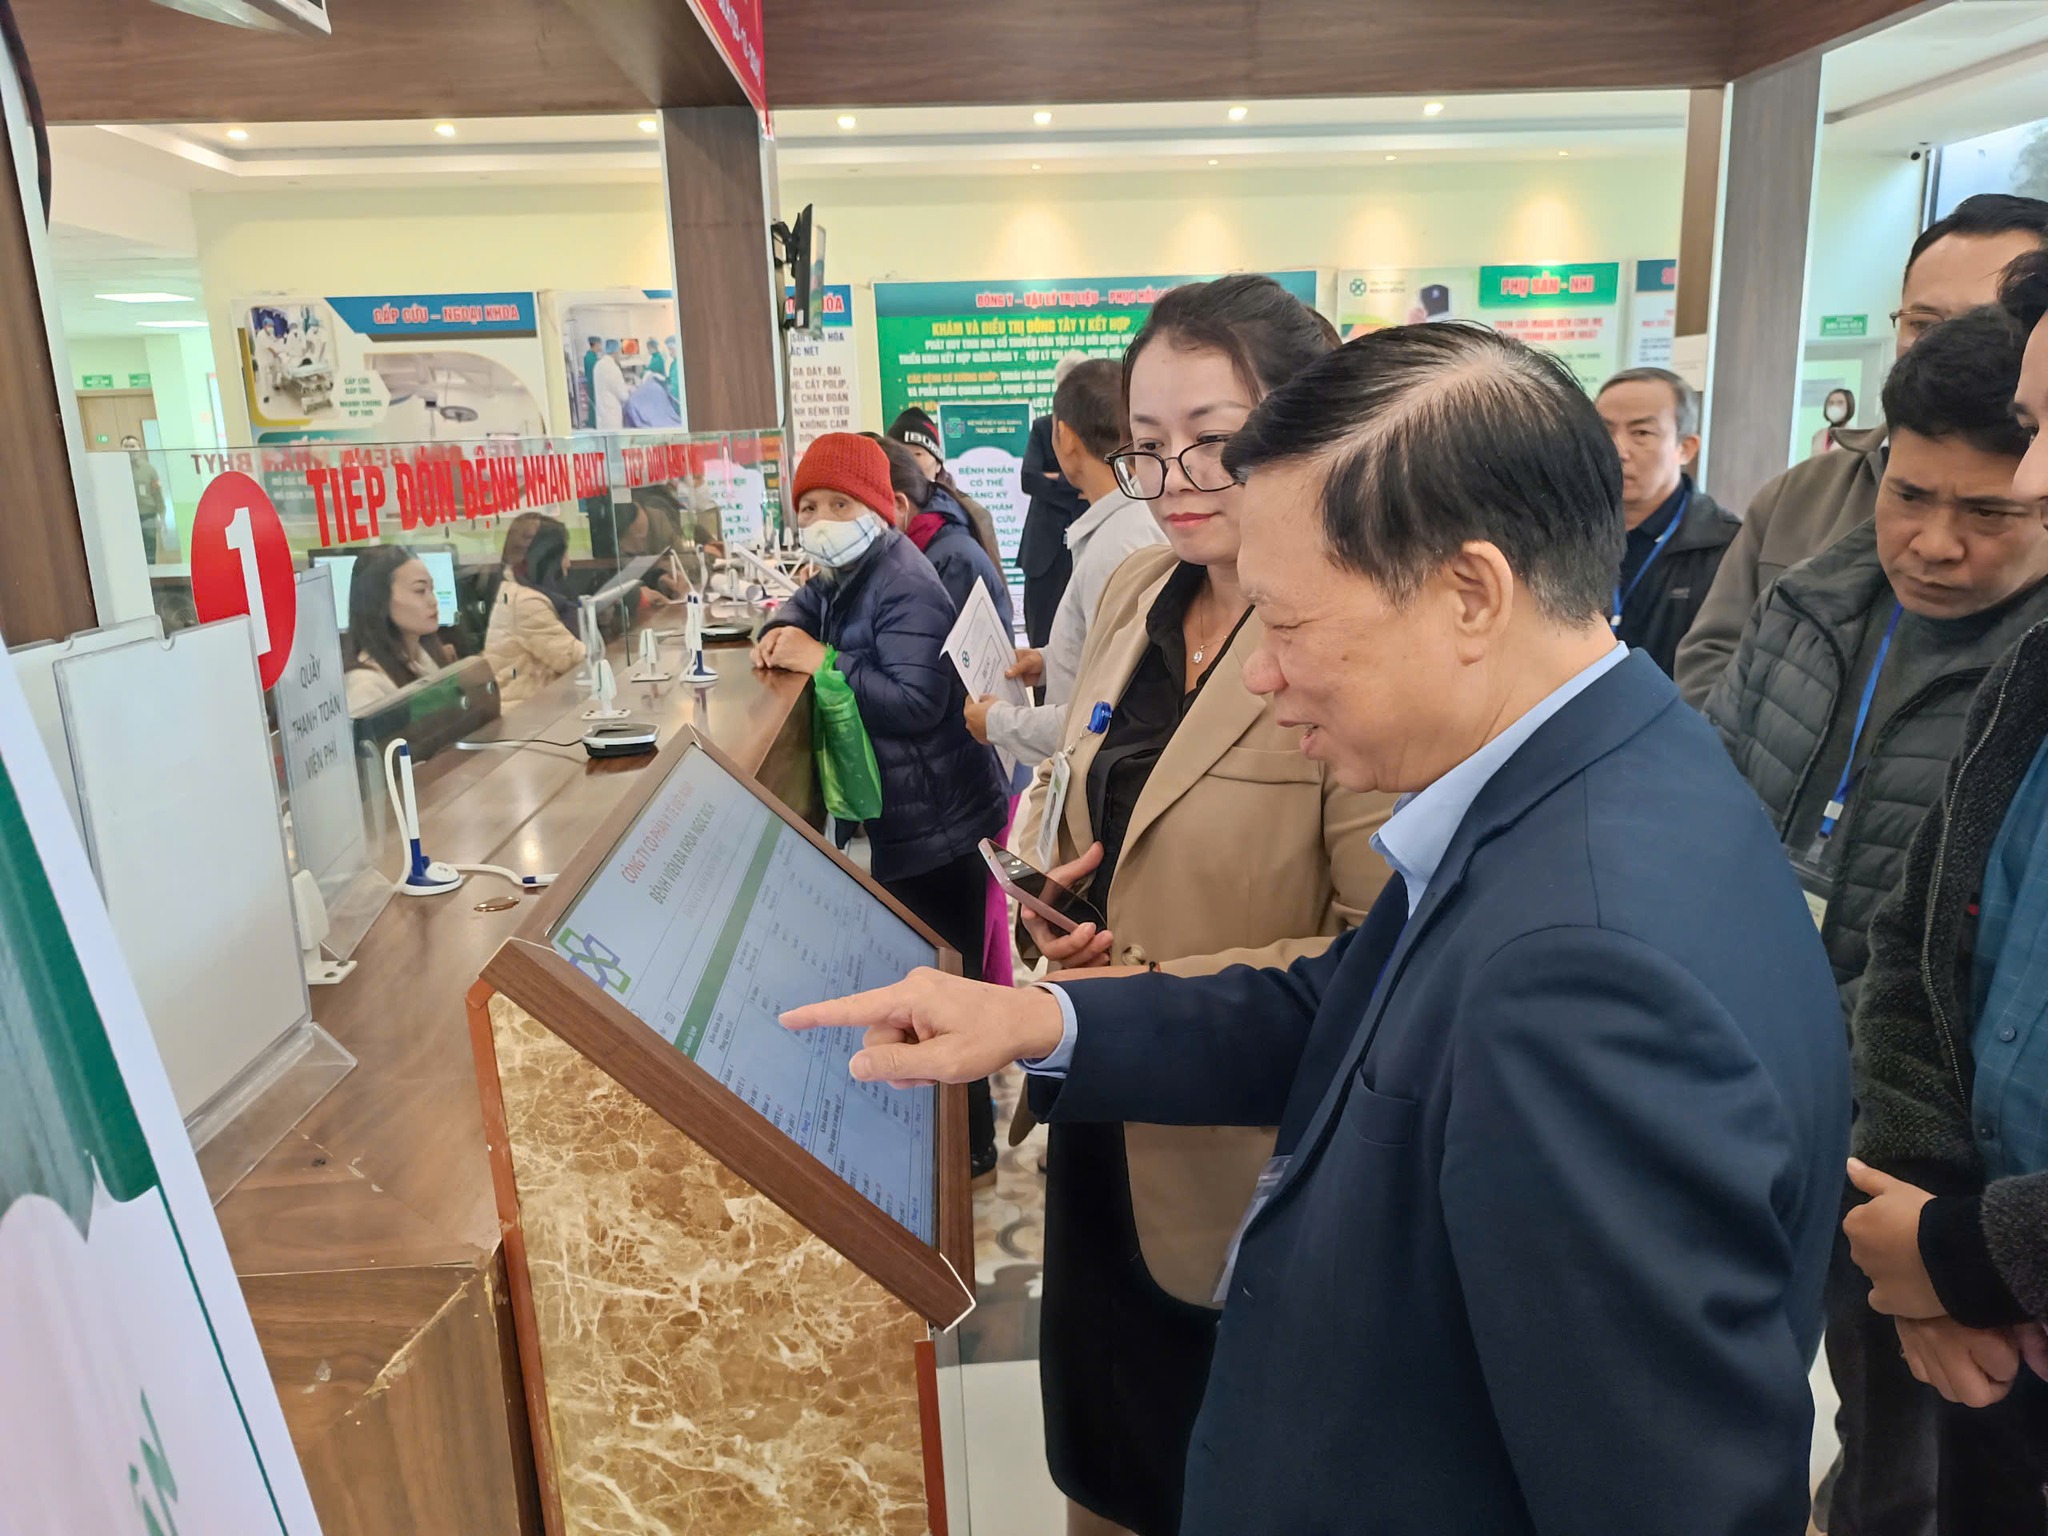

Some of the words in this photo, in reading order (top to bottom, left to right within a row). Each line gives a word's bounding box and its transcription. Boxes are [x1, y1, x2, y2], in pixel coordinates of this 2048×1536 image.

[373, 303, 400, 324] CẤP
[402, 303, 429, 323] CỨU
[442, 305, 483, 325] NGOẠI
[484, 304, 520, 321] KHOA
[460, 445, 520, 529] BỆNH
[522, 442, 571, 508] NHÂN
[573, 452, 607, 499] BHYT
[987, 466, 1014, 475] NHÂN
[225, 507, 271, 657] 1
[292, 710, 318, 743] THANH
[318, 692, 342, 729] TOÁN
[304, 743, 325, 780] VIỆN
[619, 854, 646, 884] CÔNG
[648, 874, 673, 905] BỆNH
[678, 829, 699, 855] KHOA
